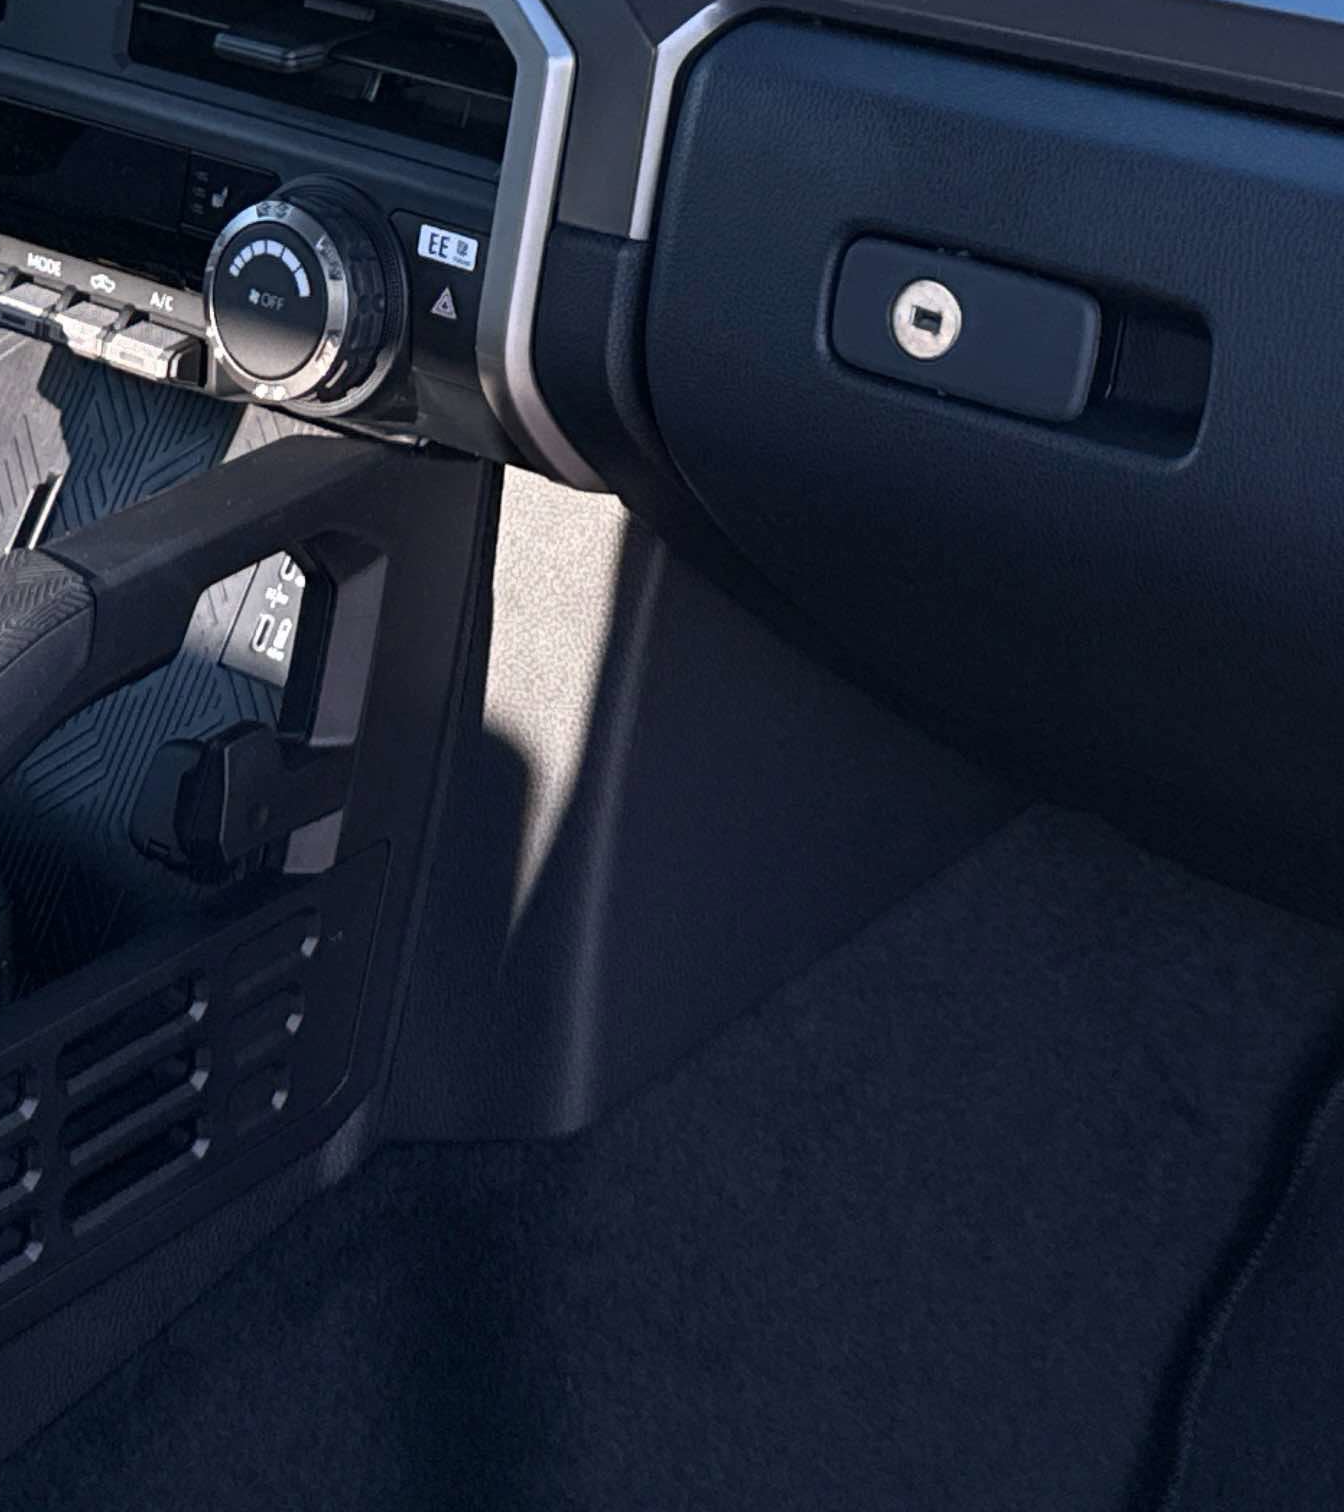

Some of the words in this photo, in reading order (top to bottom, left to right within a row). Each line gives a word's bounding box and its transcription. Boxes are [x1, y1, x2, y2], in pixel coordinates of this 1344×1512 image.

[428, 232, 451, 259] EE
[27, 252, 62, 277] MODE
[150, 291, 174, 312] A/C
[261, 293, 285, 311] OFF
